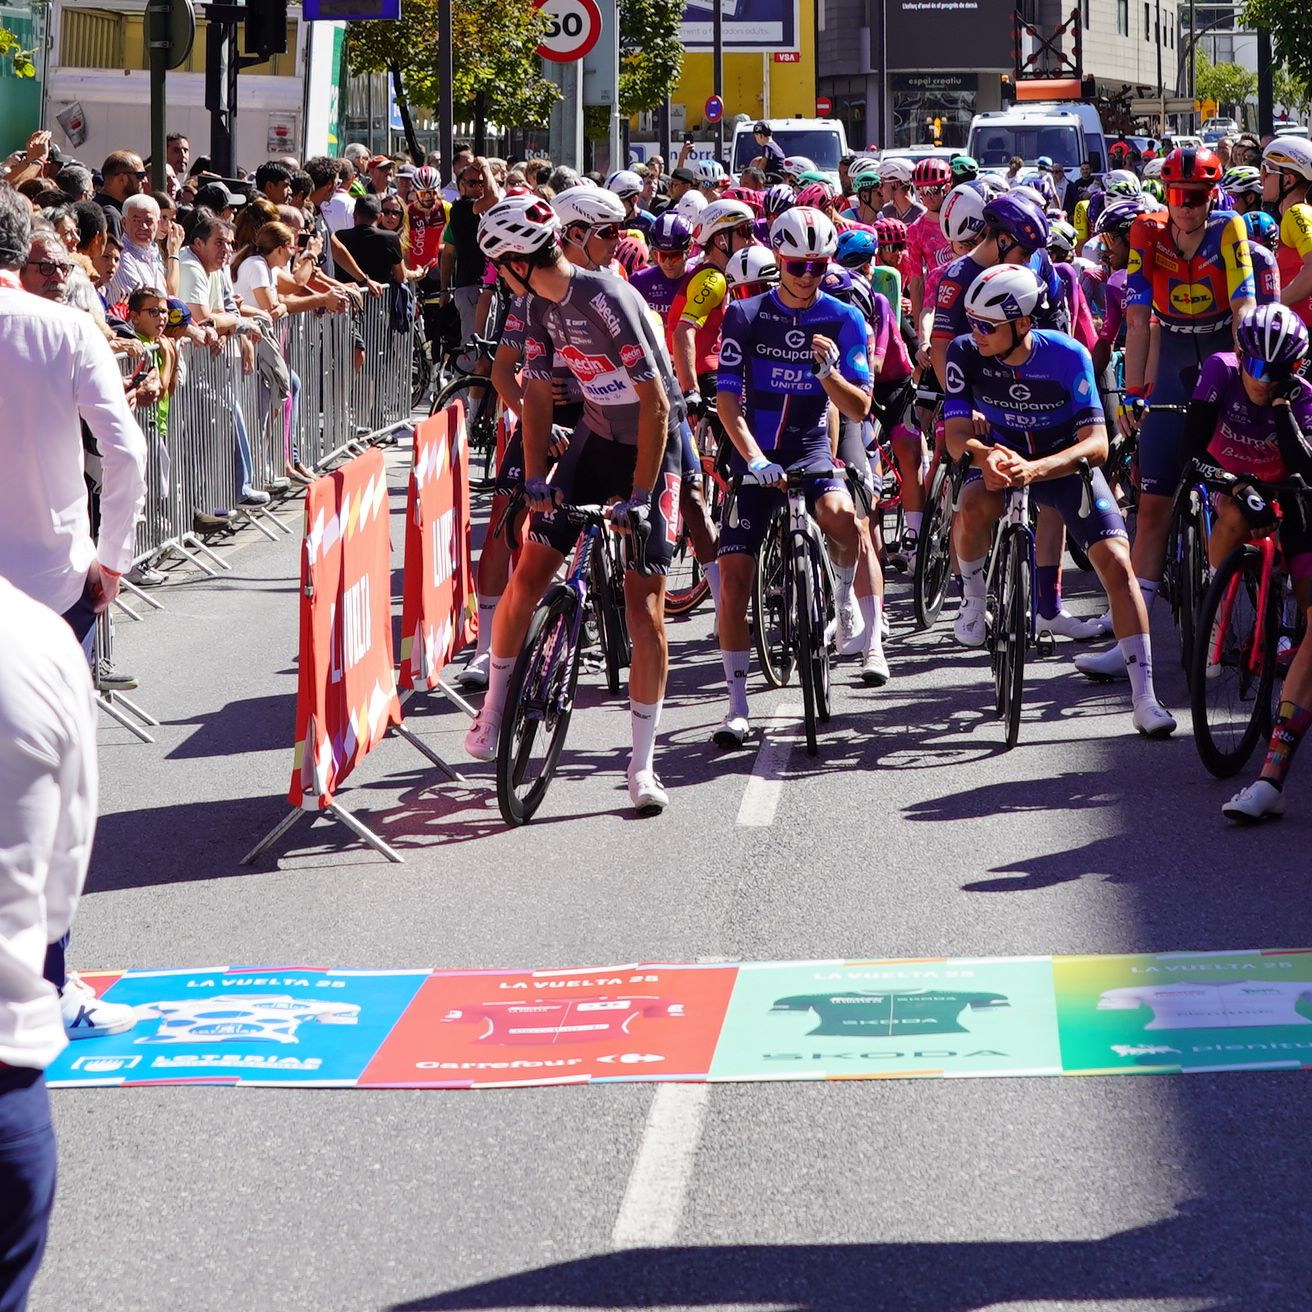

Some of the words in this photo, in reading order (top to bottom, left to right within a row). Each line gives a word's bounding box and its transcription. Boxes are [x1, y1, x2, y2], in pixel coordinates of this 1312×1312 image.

[908, 77, 930, 86] espai
[933, 76, 962, 85] creatiu
[412, 219, 426, 256] Cofidis
[694, 270, 721, 306] Cofidis
[590, 291, 623, 338] Alpecin
[1159, 315, 1234, 335] TREK
[771, 367, 803, 382] FDJ
[770, 380, 813, 391] UNITED
[981, 394, 1065, 413] Groupama
[1004, 413, 1037, 425] FDJ
[667, 480, 680, 533] Alpecin
[1164, 962, 1256, 972] VUELTA
[500, 980, 529, 989] LA
[533, 978, 623, 988] VUELTA
[629, 975, 659, 983] 25
[814, 973, 845, 981] LA
[847, 971, 939, 980] VUELTA
[945, 970, 975, 978] 25
[186, 980, 219, 989] LA
[221, 979, 310, 988] VUELTA
[316, 980, 346, 988] 25
